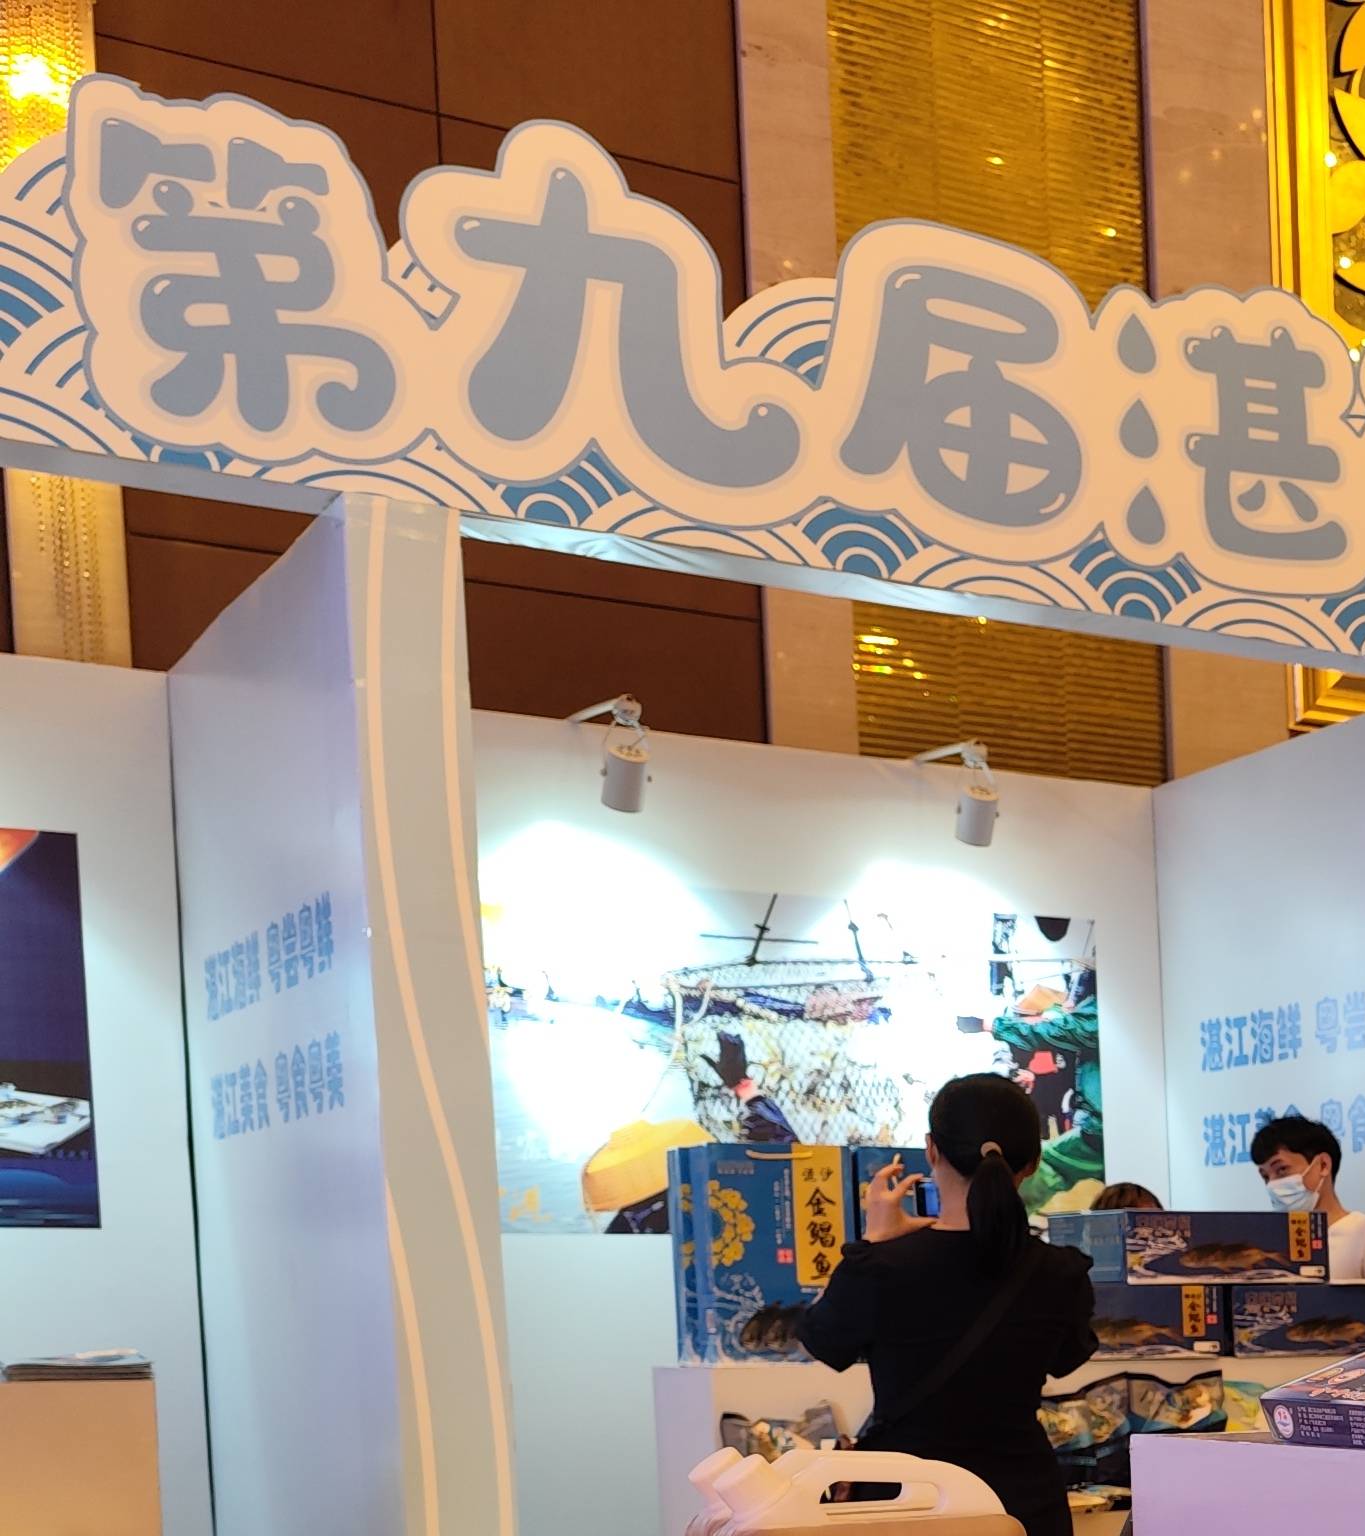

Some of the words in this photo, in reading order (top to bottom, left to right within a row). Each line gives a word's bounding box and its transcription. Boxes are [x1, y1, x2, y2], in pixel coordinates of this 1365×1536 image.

[1200, 1001, 1302, 1072] 湛江海鲜
[1203, 1104, 1304, 1167] 湛江
